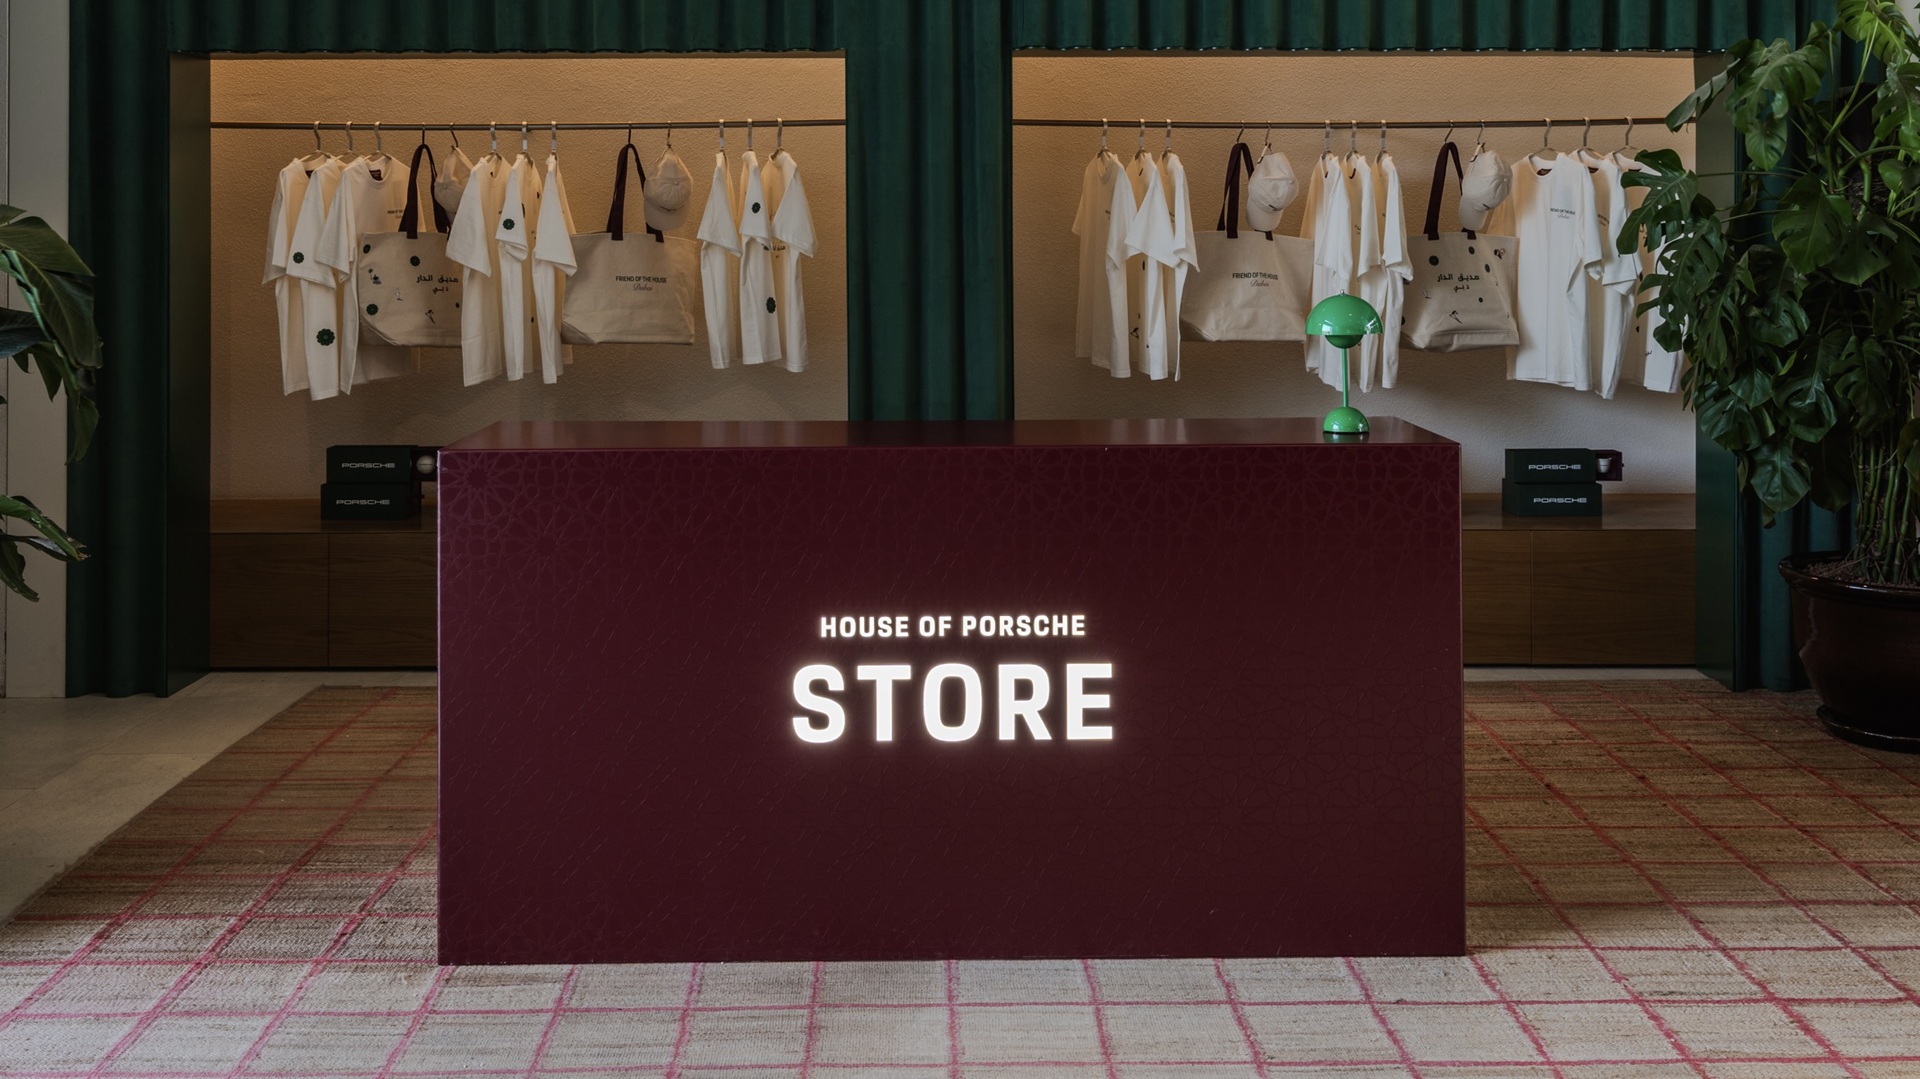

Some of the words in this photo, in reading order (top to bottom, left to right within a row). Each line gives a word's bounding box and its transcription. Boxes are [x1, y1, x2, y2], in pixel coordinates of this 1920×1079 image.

[820, 616, 909, 637] HOUSE
[919, 616, 952, 637] OF
[962, 615, 1085, 637] PORSCHE
[792, 663, 1113, 742] STORE
